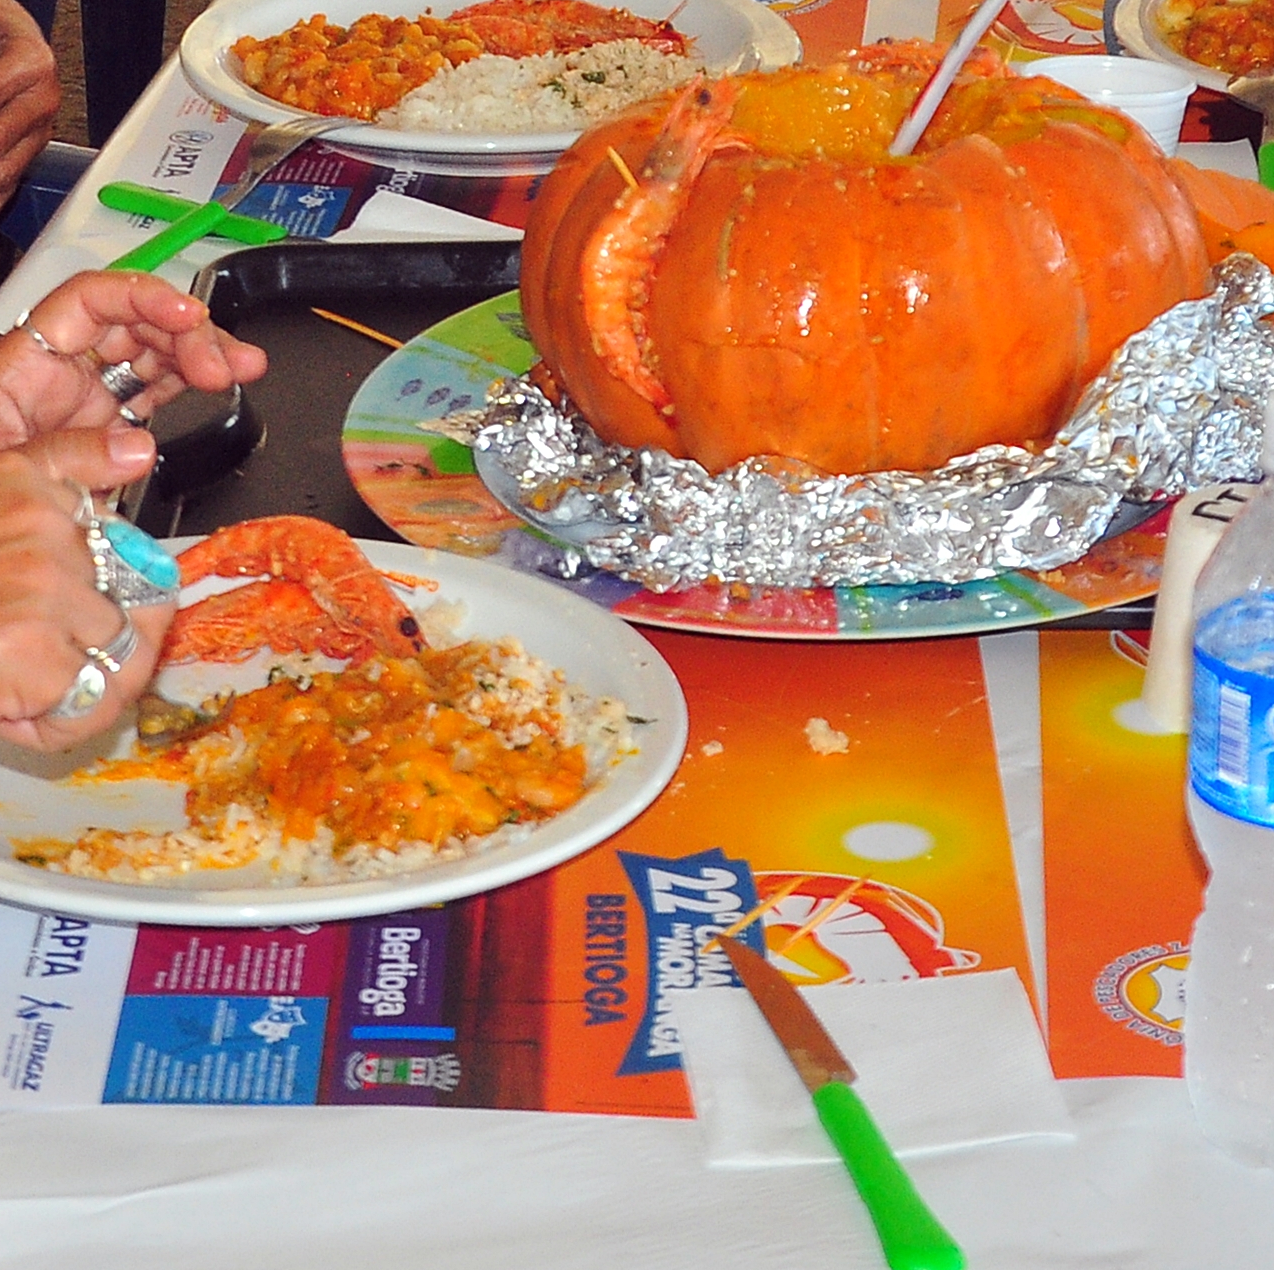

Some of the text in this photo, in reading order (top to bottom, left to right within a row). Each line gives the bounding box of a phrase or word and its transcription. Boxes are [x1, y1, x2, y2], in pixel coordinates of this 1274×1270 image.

[41, 916, 91, 977] APTA
[358, 926, 422, 1018] Bertioga
[583, 893, 628, 1027] BERTIOGA
[22, 1022, 55, 1092] ULTRAGAZ
